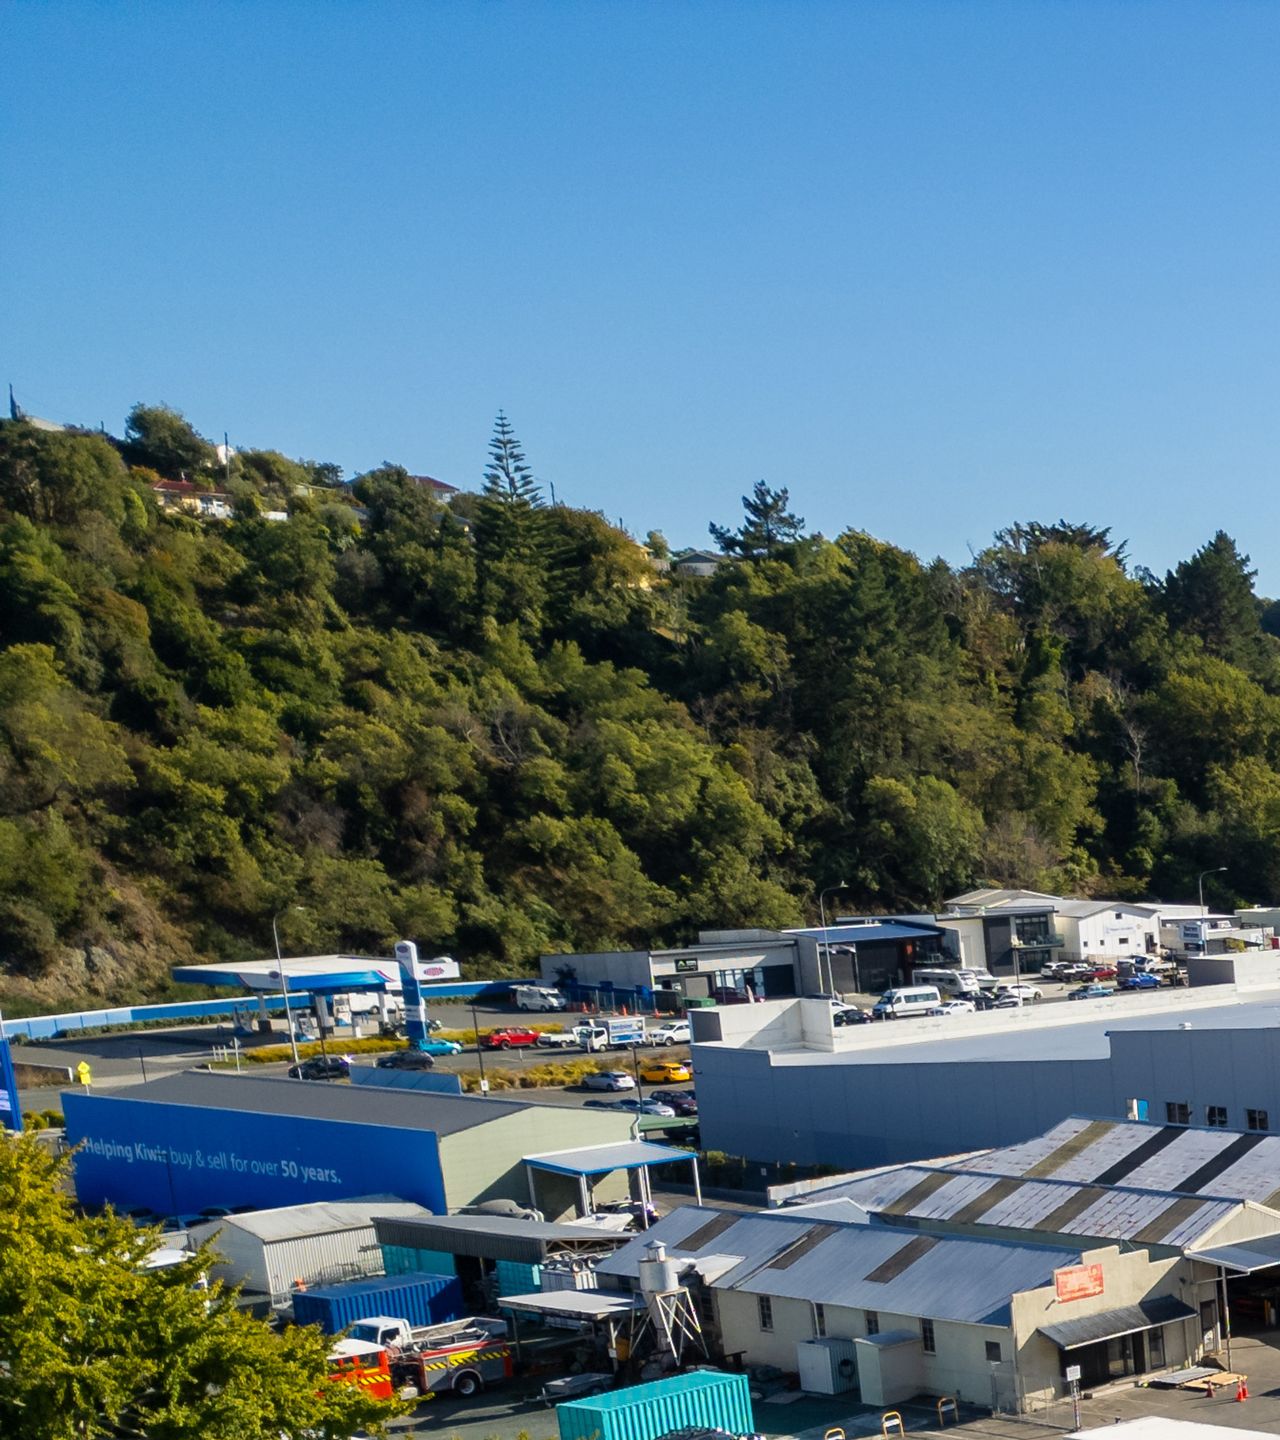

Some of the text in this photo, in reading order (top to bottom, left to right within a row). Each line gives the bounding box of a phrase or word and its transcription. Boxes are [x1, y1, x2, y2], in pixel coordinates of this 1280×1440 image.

[85, 1138, 134, 1163] Helping
[169, 1149, 193, 1171] buy
[195, 1152, 205, 1168] &
[207, 1153, 228, 1170] sell
[230, 1154, 248, 1173] for
[250, 1161, 278, 1176] over
[280, 1160, 298, 1178] 50
[300, 1165, 342, 1184] years.
